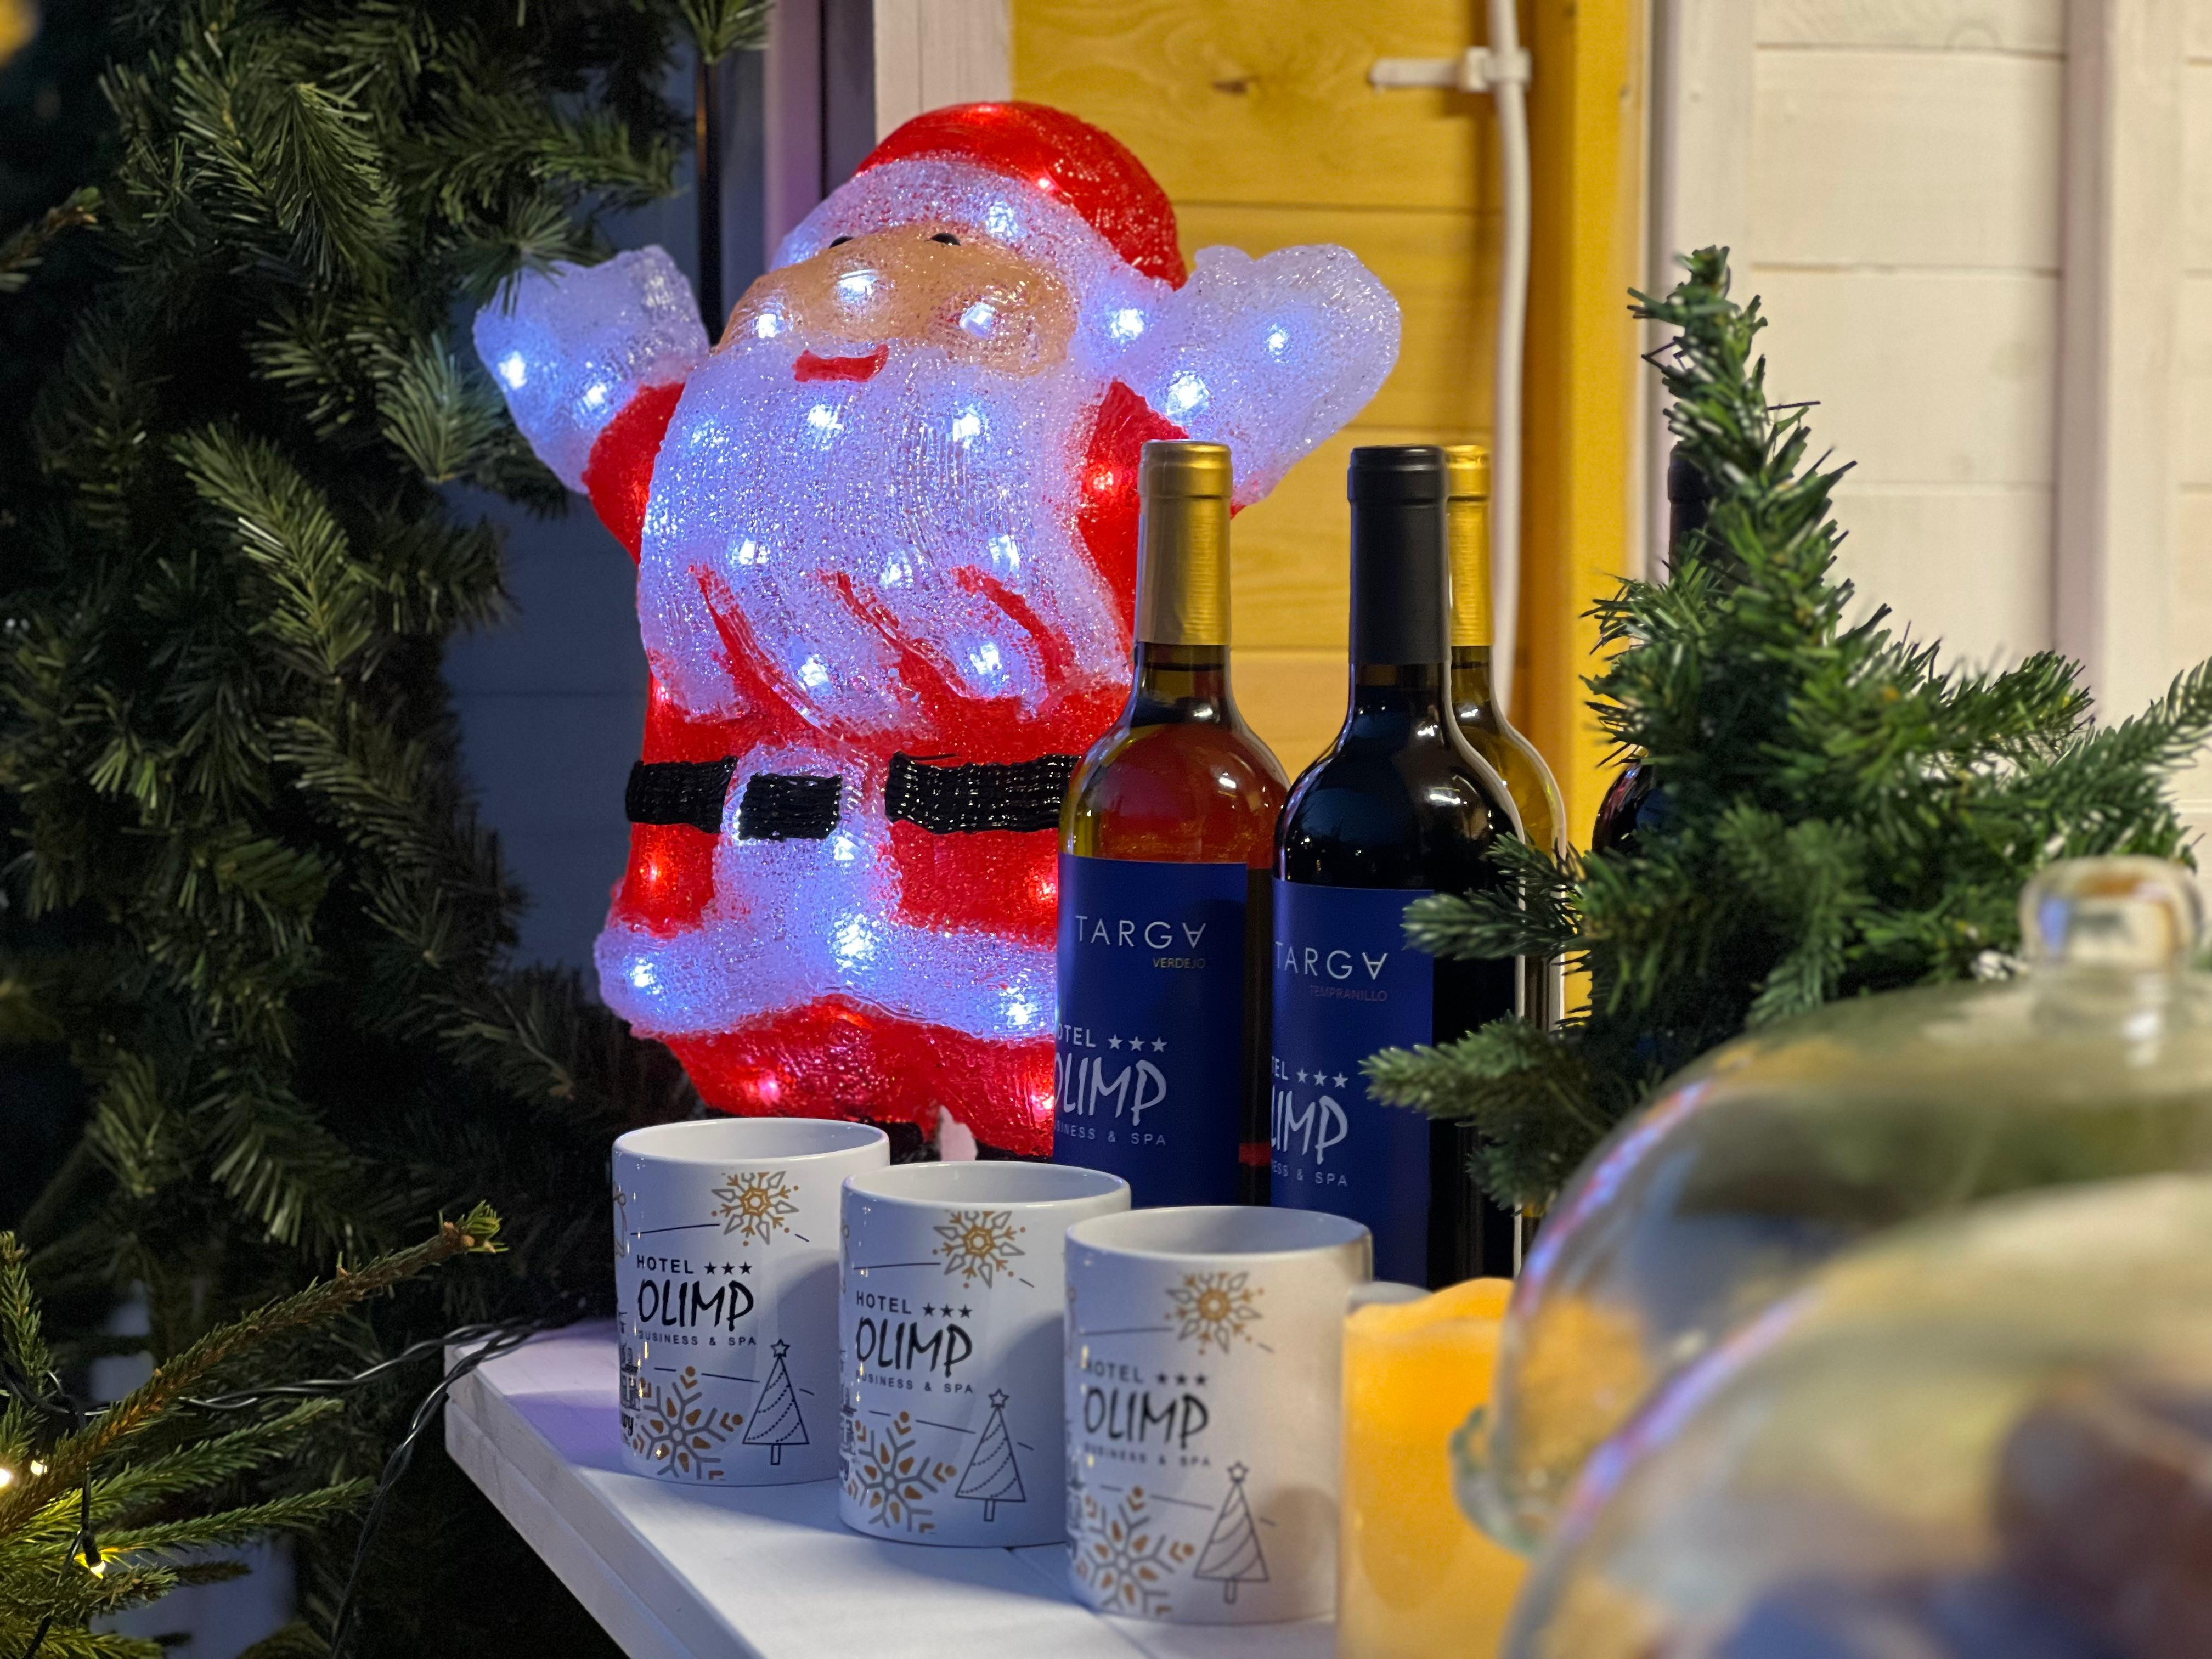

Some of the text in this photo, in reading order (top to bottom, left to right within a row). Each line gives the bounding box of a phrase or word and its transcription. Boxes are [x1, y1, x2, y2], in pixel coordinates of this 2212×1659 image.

[1153, 957, 1206, 969] VERDEJO
[1057, 1023, 1096, 1048] OTEL
[1271, 1085, 1348, 1165] LIMP
[1108, 1131, 1116, 1143] &
[1131, 1132, 1166, 1146] SPA
[1296, 1169, 1347, 1186] & SPA
[637, 1255, 694, 1274] HOTEL
[638, 1279, 754, 1332] OLIMP
[856, 1290, 912, 1314] HOTEL
[638, 1330, 757, 1346] BUSINESS & SPA
[856, 1317, 972, 1378] OLIMP
[924, 1382, 932, 1392] &
[944, 1383, 973, 1393] SPA
[1084, 1387, 1209, 1450] OLIMP
